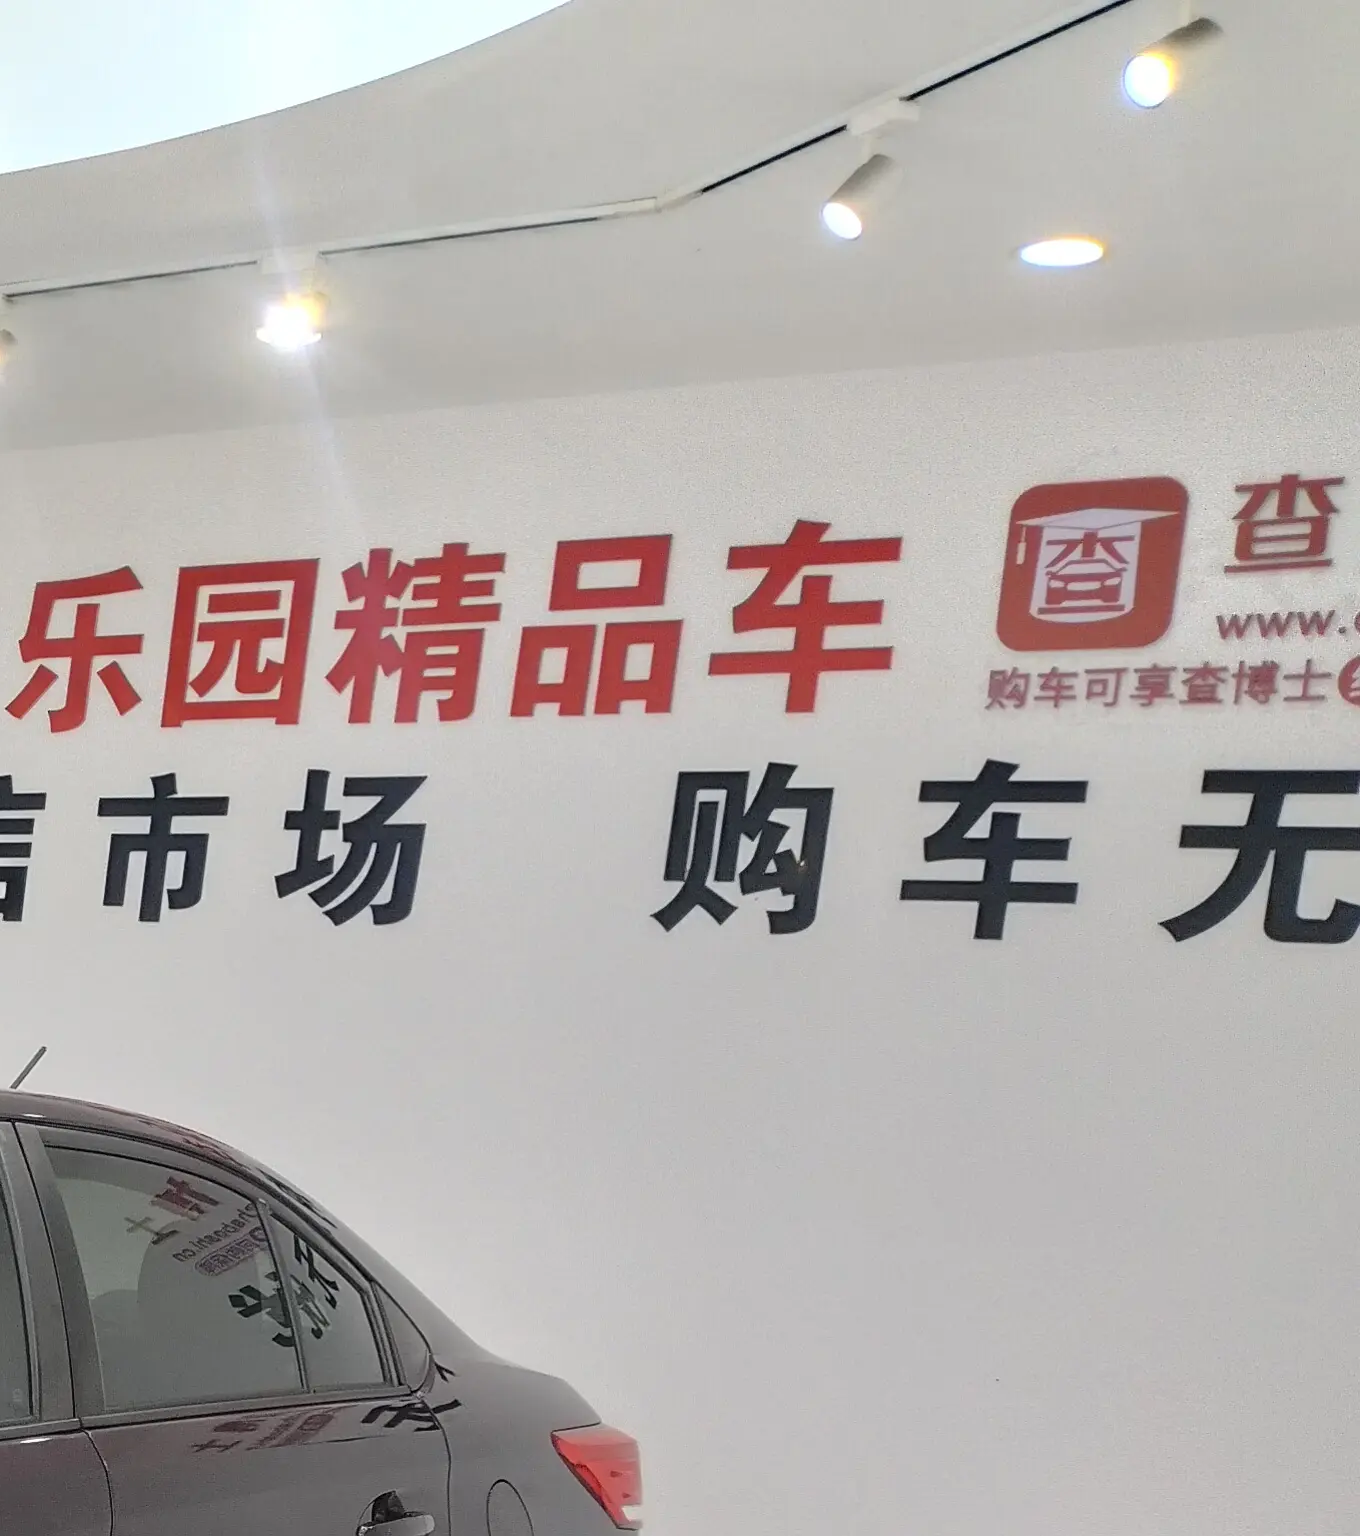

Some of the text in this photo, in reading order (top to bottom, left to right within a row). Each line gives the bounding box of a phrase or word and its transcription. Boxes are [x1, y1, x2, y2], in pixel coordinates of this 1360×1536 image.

[1223, 473, 1345, 575] 查
[1216, 609, 1360, 640] www.
[649, 758, 1360, 946] 购车无
